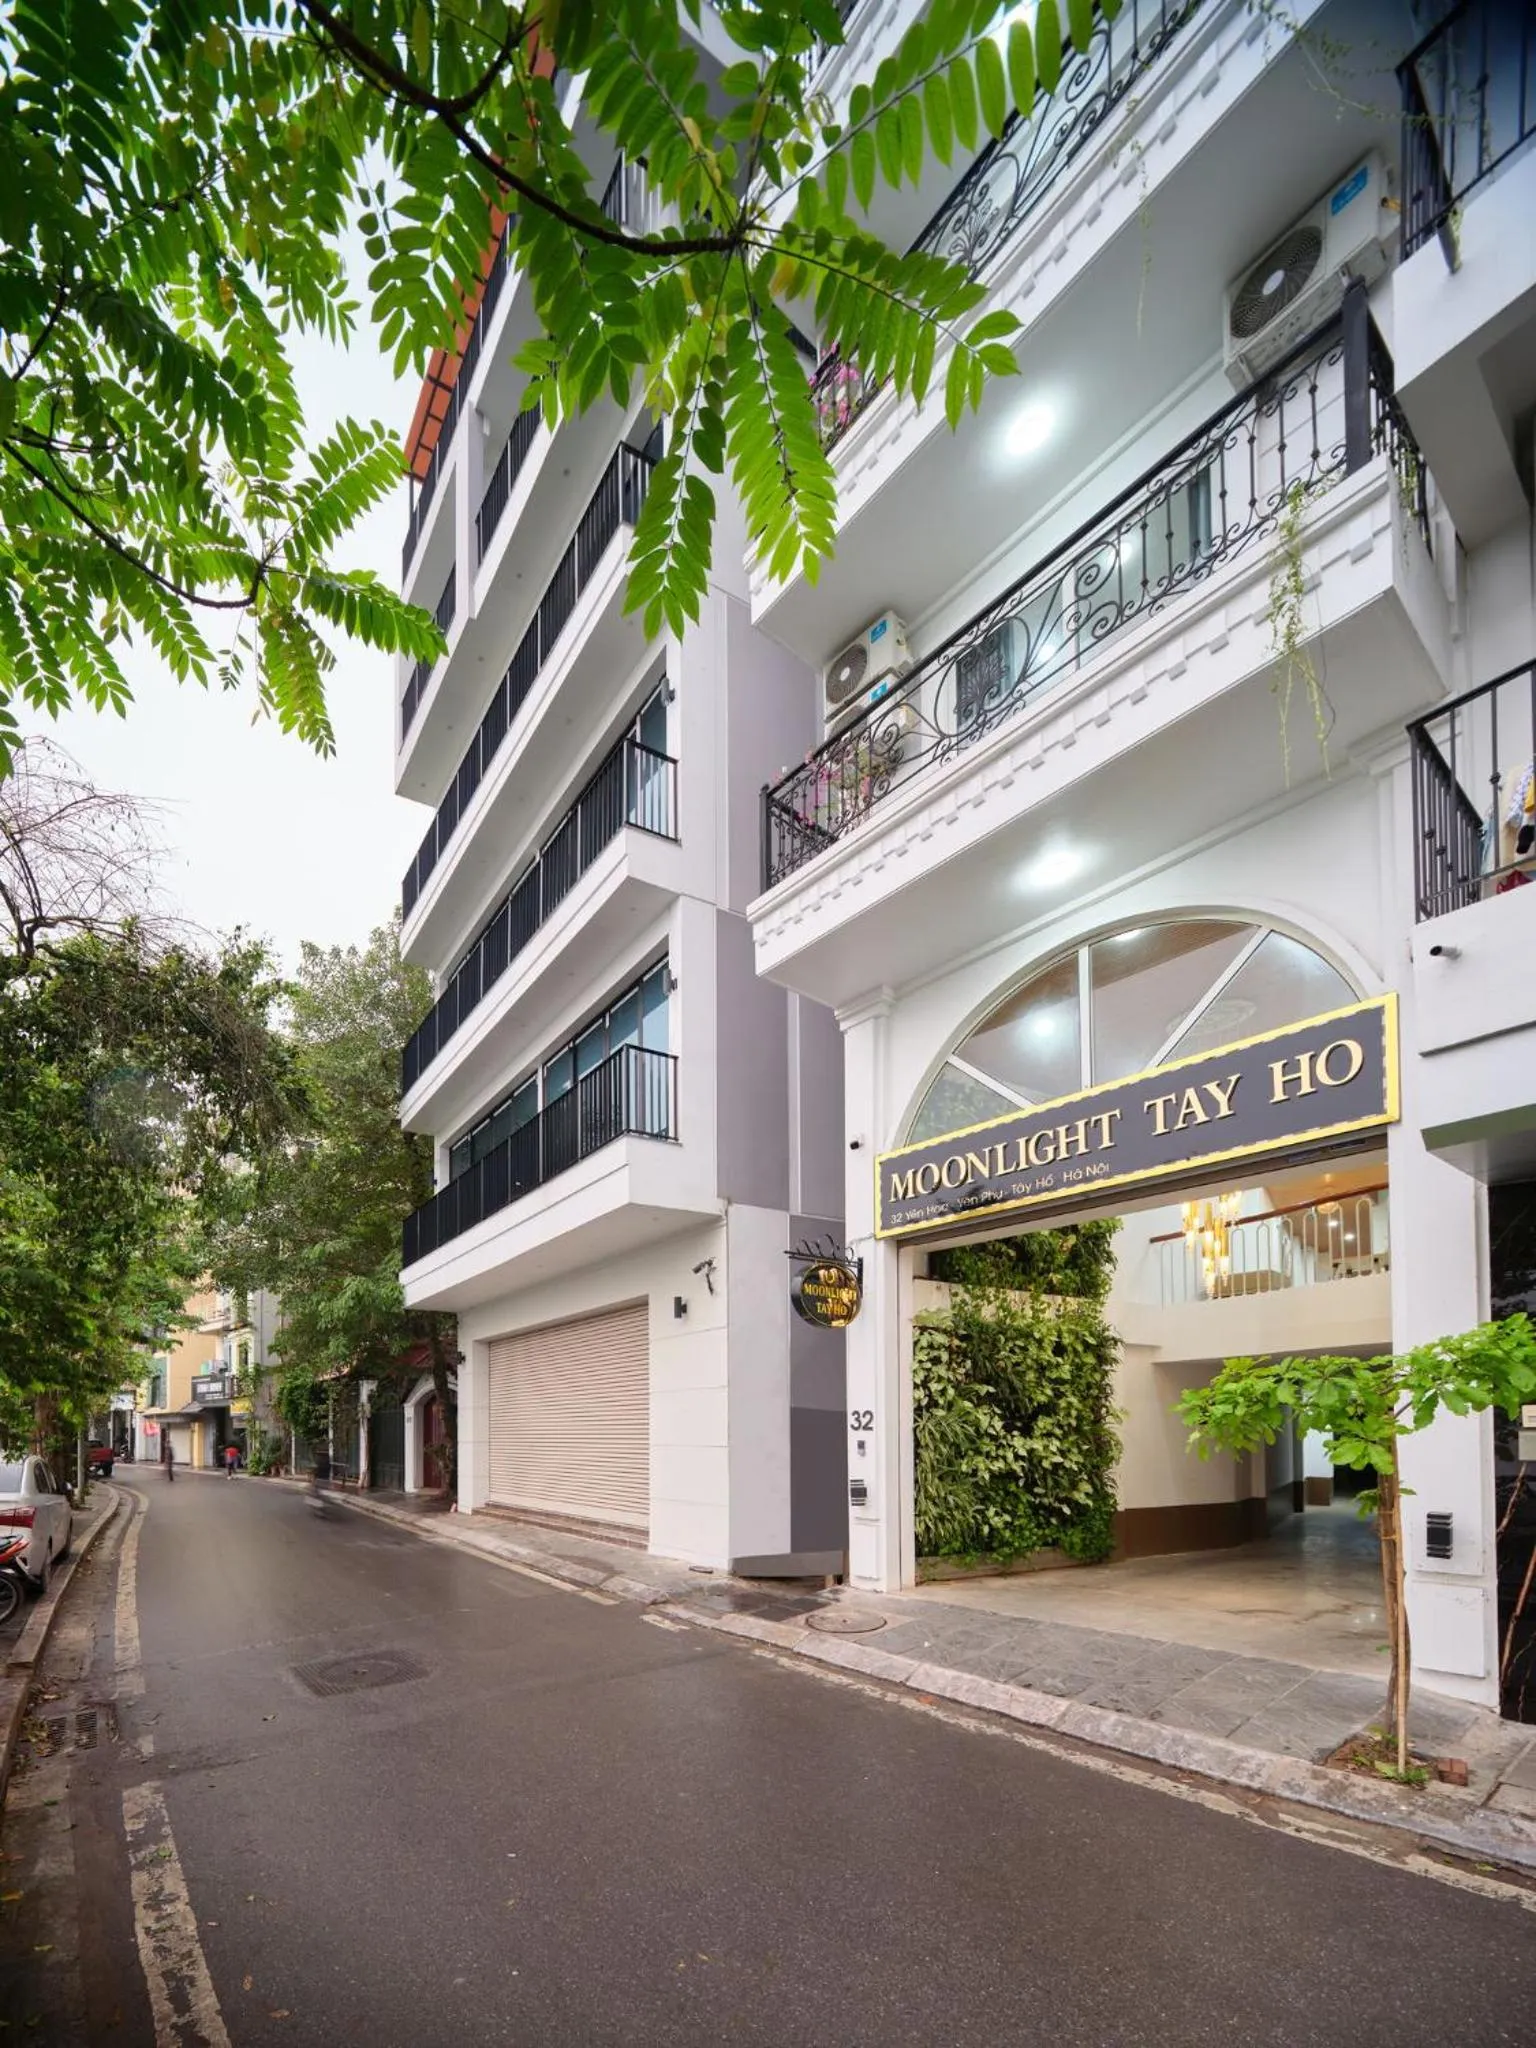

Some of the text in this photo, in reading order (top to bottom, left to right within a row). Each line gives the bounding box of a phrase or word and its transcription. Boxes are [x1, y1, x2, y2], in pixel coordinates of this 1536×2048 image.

[888, 1039, 1365, 1202] MOONLIGHT TAY HO
[890, 1212, 903, 1224] 32
[803, 1283, 857, 1300] MOONLIGHT
[816, 1302, 848, 1315] TAY HO
[850, 1410, 874, 1431] 32
